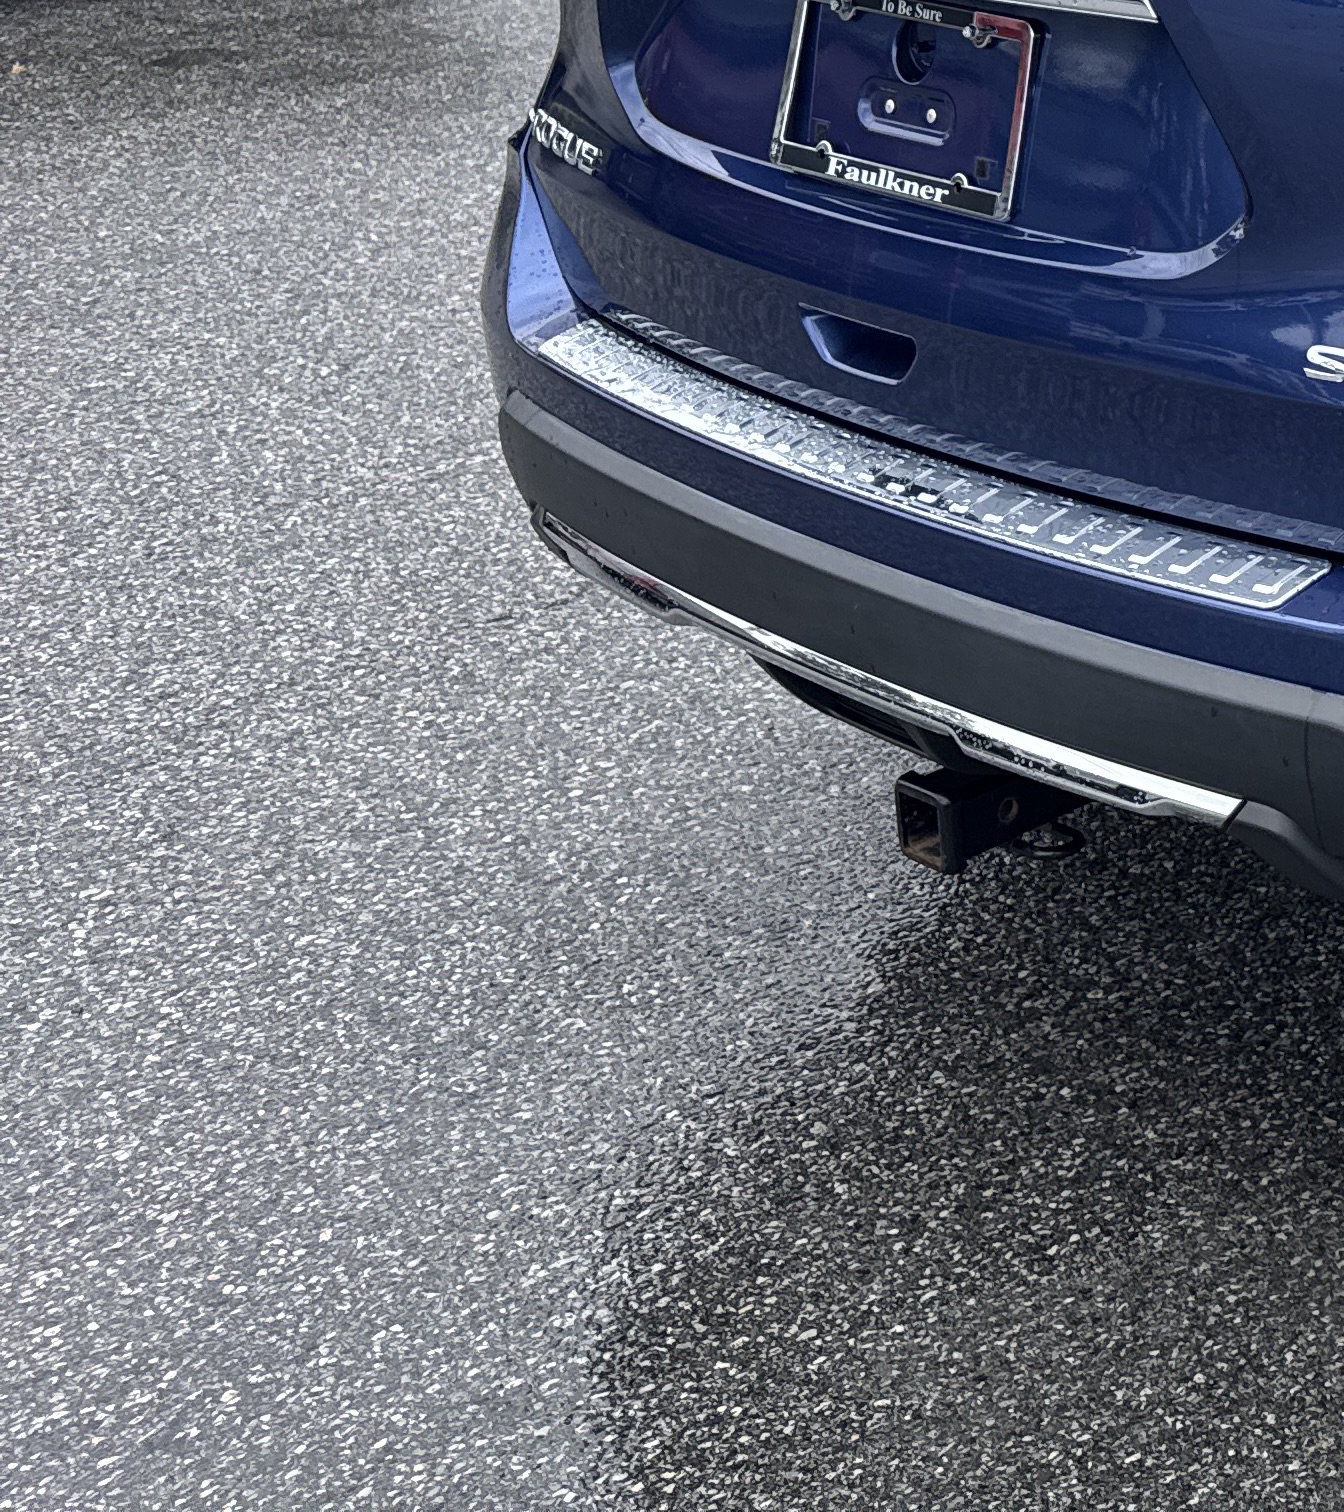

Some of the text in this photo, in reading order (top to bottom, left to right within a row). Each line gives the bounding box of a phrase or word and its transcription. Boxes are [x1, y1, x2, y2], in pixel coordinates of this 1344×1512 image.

[897, 0, 913, 17] Be
[914, 3, 943, 23] Sure
[825, 156, 950, 203] Faulkner
